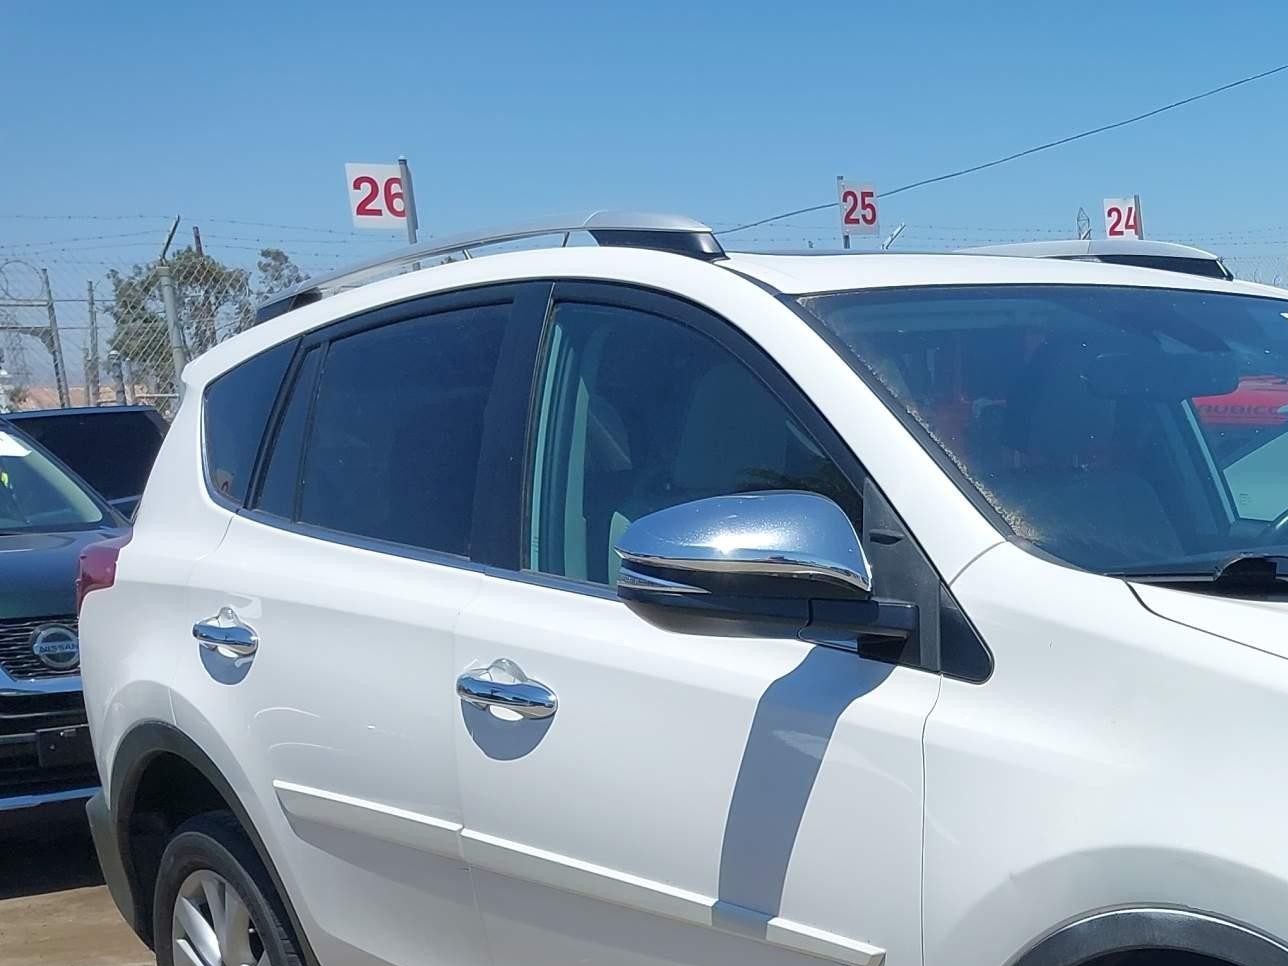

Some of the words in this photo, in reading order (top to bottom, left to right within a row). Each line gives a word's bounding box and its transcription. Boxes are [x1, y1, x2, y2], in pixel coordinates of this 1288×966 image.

[353, 175, 407, 218] 26
[842, 191, 877, 225] 25
[1107, 207, 1138, 237] 24
